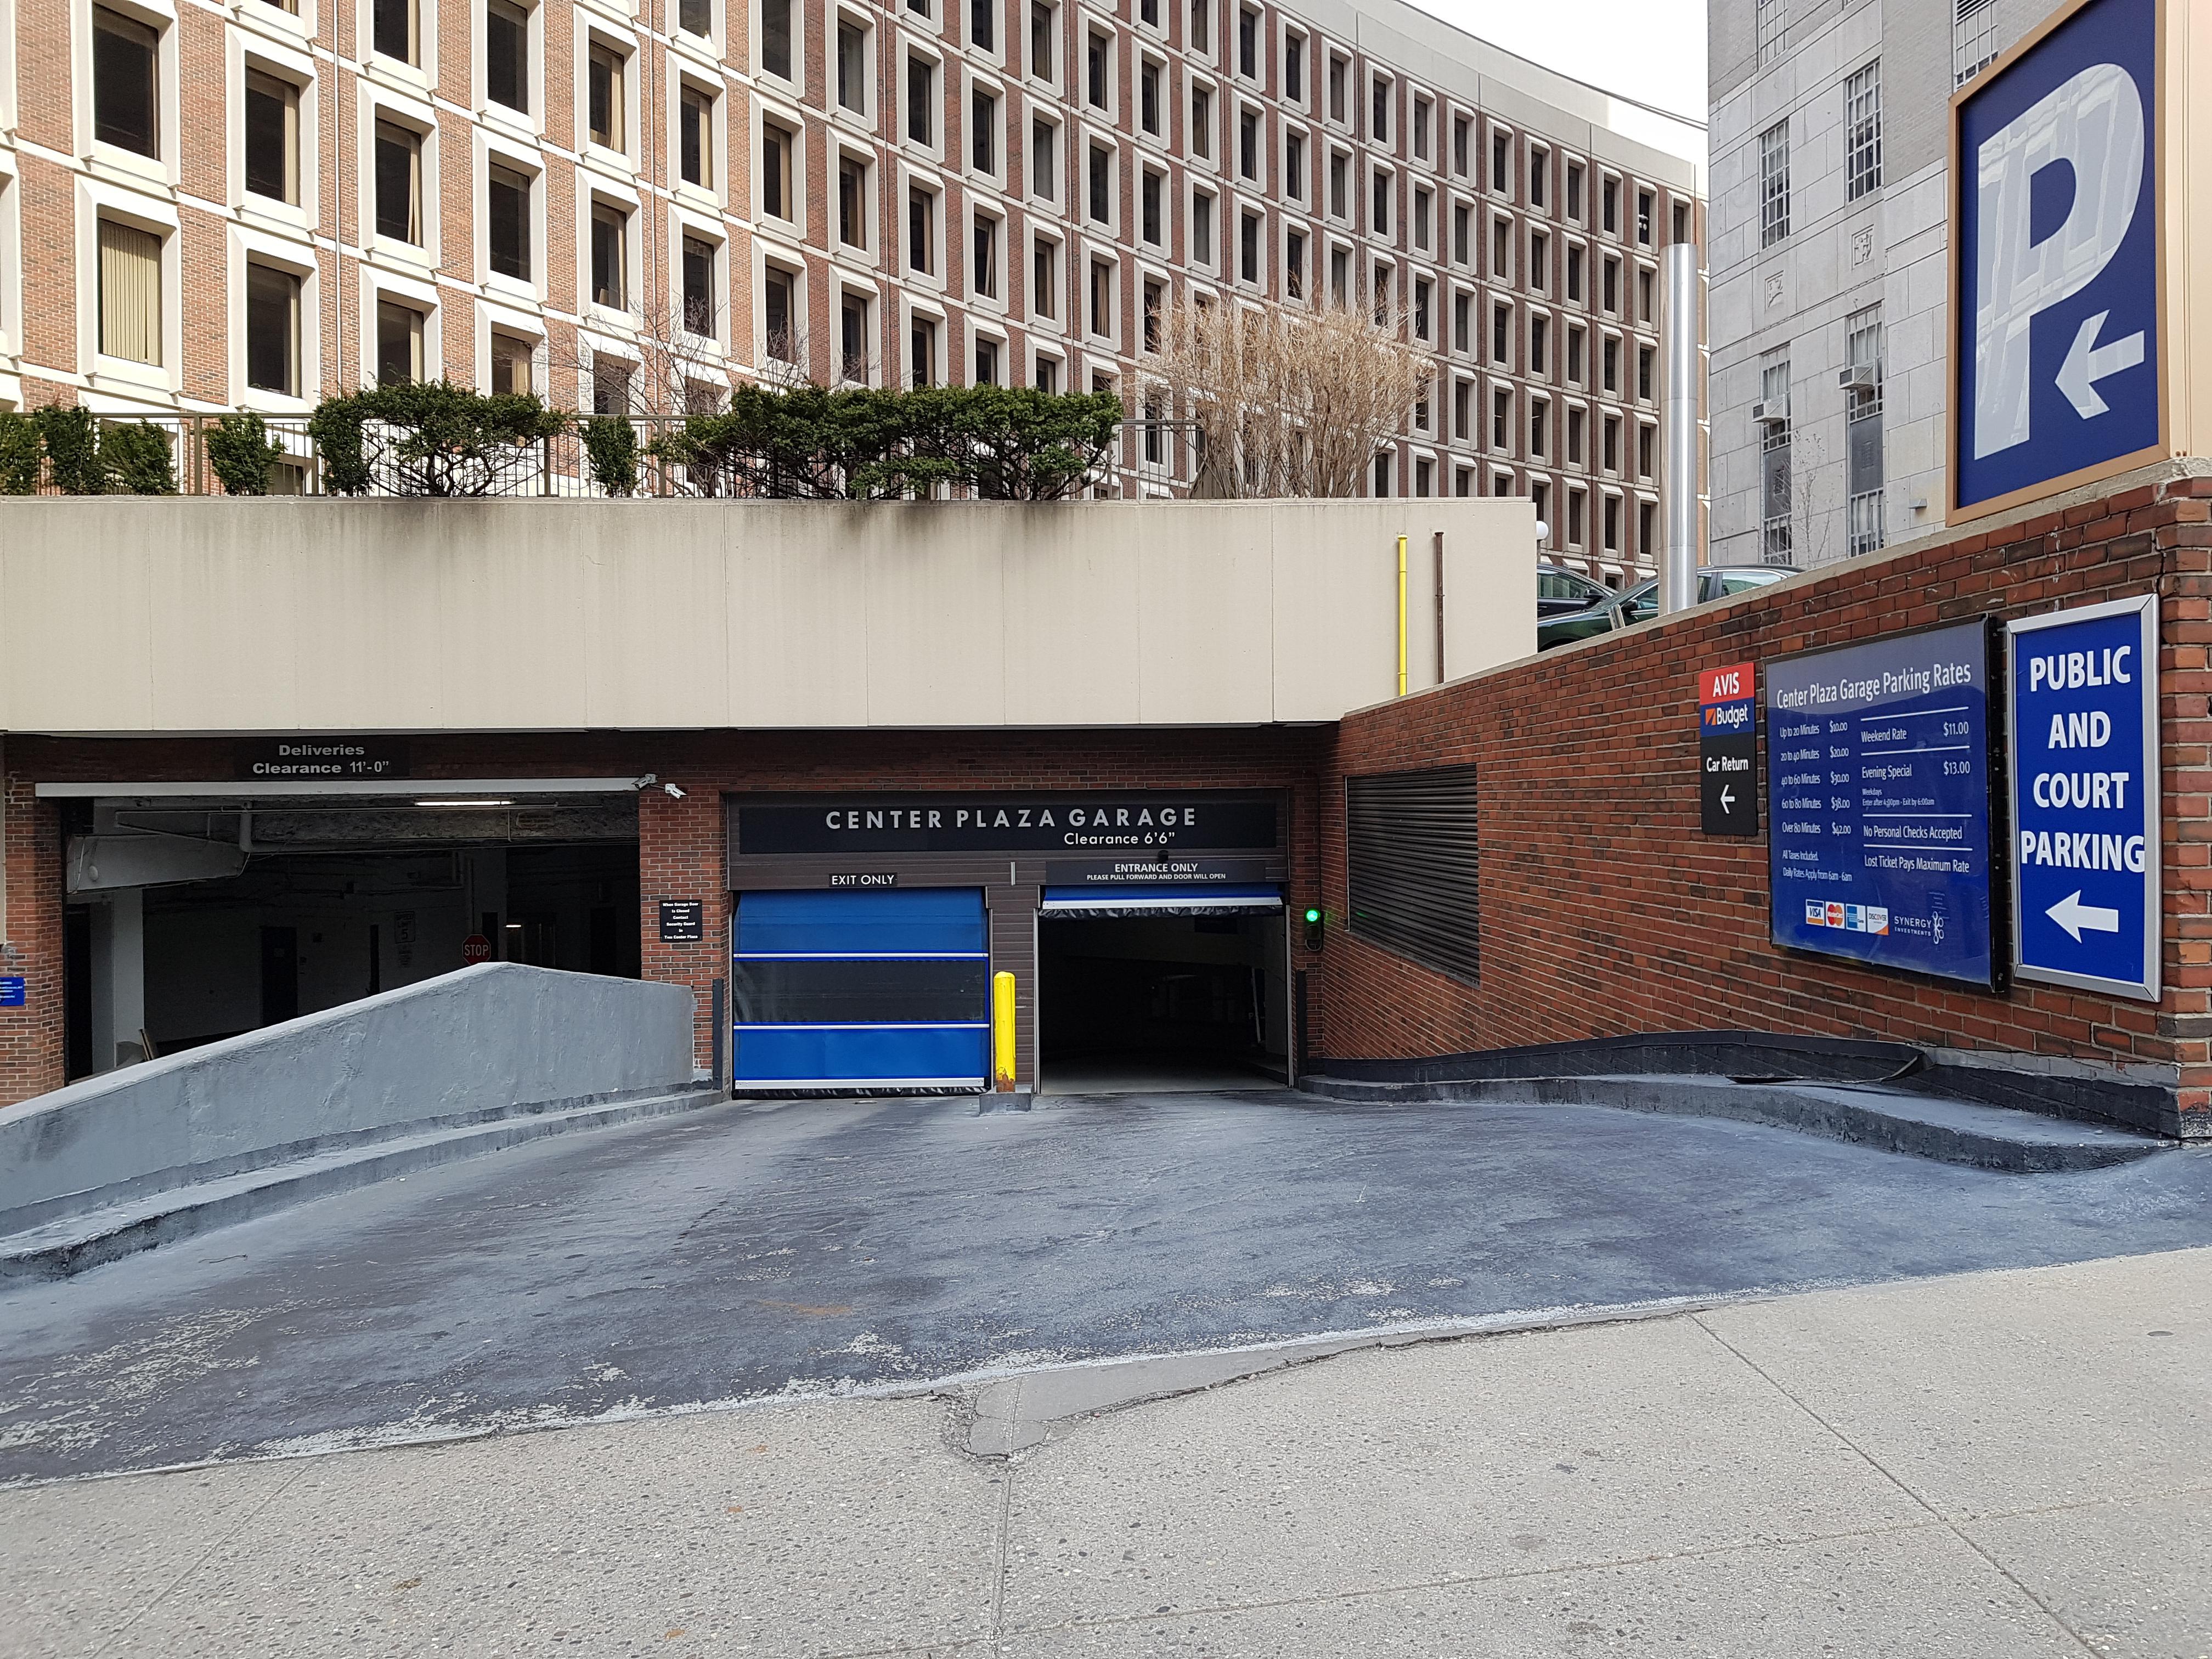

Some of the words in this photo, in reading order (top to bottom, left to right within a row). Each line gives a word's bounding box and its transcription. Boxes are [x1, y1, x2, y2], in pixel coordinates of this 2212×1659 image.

[1975, 63, 2145, 460] P
[2030, 645, 2131, 692] PUBLIC
[1713, 672, 1740, 697] AVIS
[1777, 689, 1808, 709] Center
[1810, 682, 1837, 704] Plaza
[1840, 679, 1880, 702] Garage
[1883, 667, 1930, 694] Parking
[1934, 663, 1971, 687] Rates
[1717, 704, 1748, 729] Budget
[1780, 727, 1787, 740] Up
[1787, 727, 1792, 736] to
[1801, 724, 1820, 735] Minutes
[1830, 720, 1848, 733] $10.00
[1861, 729, 1890, 743] Weekend
[1892, 728, 1907, 740] Rate
[1944, 721, 1969, 737] $11.00
[2048, 711, 2111, 749] AND
[279, 744, 365, 755] Deliveries
[1781, 753, 1787, 761] 20
[1787, 751, 1792, 760] to
[1793, 752, 1800, 763] 40
[1801, 749, 1820, 760] Minutes
[1830, 746, 1849, 759] $20.00
[253, 763, 342, 774] Clearance
[1707, 757, 1720, 772] Car
[1722, 756, 1748, 771] Return
[1862, 766, 1887, 780] Evening
[1888, 764, 1912, 780] Special
[1944, 761, 1970, 776] $13.00
[1781, 776, 1788, 787] 40
[1788, 775, 1793, 785] to
[1794, 774, 1801, 785] 60
[1801, 774, 1820, 784] Minutes
[1831, 771, 1849, 786] $30.00
[1862, 788, 1882, 797] Weekdays
[2033, 772, 2129, 809] COURT
[1782, 799, 1788, 809] 60
[1789, 799, 1794, 809] to
[1795, 799, 1801, 809] 80
[1802, 798, 1821, 809] Minutes
[1831, 796, 1850, 811] $38.00
[1911, 798, 1917, 806] by
[826, 810, 942, 830] CENTER
[957, 810, 1056, 828] PLAZA
[1069, 808, 1195, 827] GARAGE
[1782, 822, 1794, 833] Over
[1794, 823, 1801, 833] 80
[1802, 822, 1821, 833] Minutes
[1832, 822, 1852, 837] $42.00
[1864, 825, 1872, 837] No
[1874, 825, 1901, 838] Personal
[1903, 826, 1928, 838] Checks
[1929, 826, 1962, 842] Accepted
[1064, 832, 1138, 845] Clearance
[1788, 850, 1800, 860] Taxes
[2021, 831, 2145, 873] PARKING
[1115, 864, 1168, 872] ENTRANCE
[1171, 863, 1198, 872] ONLY
[1865, 855, 1878, 867] Lost
[1878, 856, 1898, 868] Ticket
[1899, 857, 1915, 872] Pays
[1917, 857, 1951, 872] Maximum
[1953, 859, 1970, 873] Rate
[832, 876, 856, 885] EXIT
[861, 875, 894, 885] ONLY
[1783, 867, 1793, 878] Daily
[1793, 868, 1805, 878] Rates
[1805, 869, 1818, 881] Apply
[1818, 870, 1828, 879] from
[1829, 871, 1838, 880] 6am
[1842, 872, 1853, 882] 6am
[1809, 907, 1821, 918] VISA
[1869, 913, 1887, 921] DISCOVER
[1894, 916, 1932, 928] SYNERGY
[1894, 927, 1931, 936] INVESTMENTS
[465, 945, 489, 956] STOP
